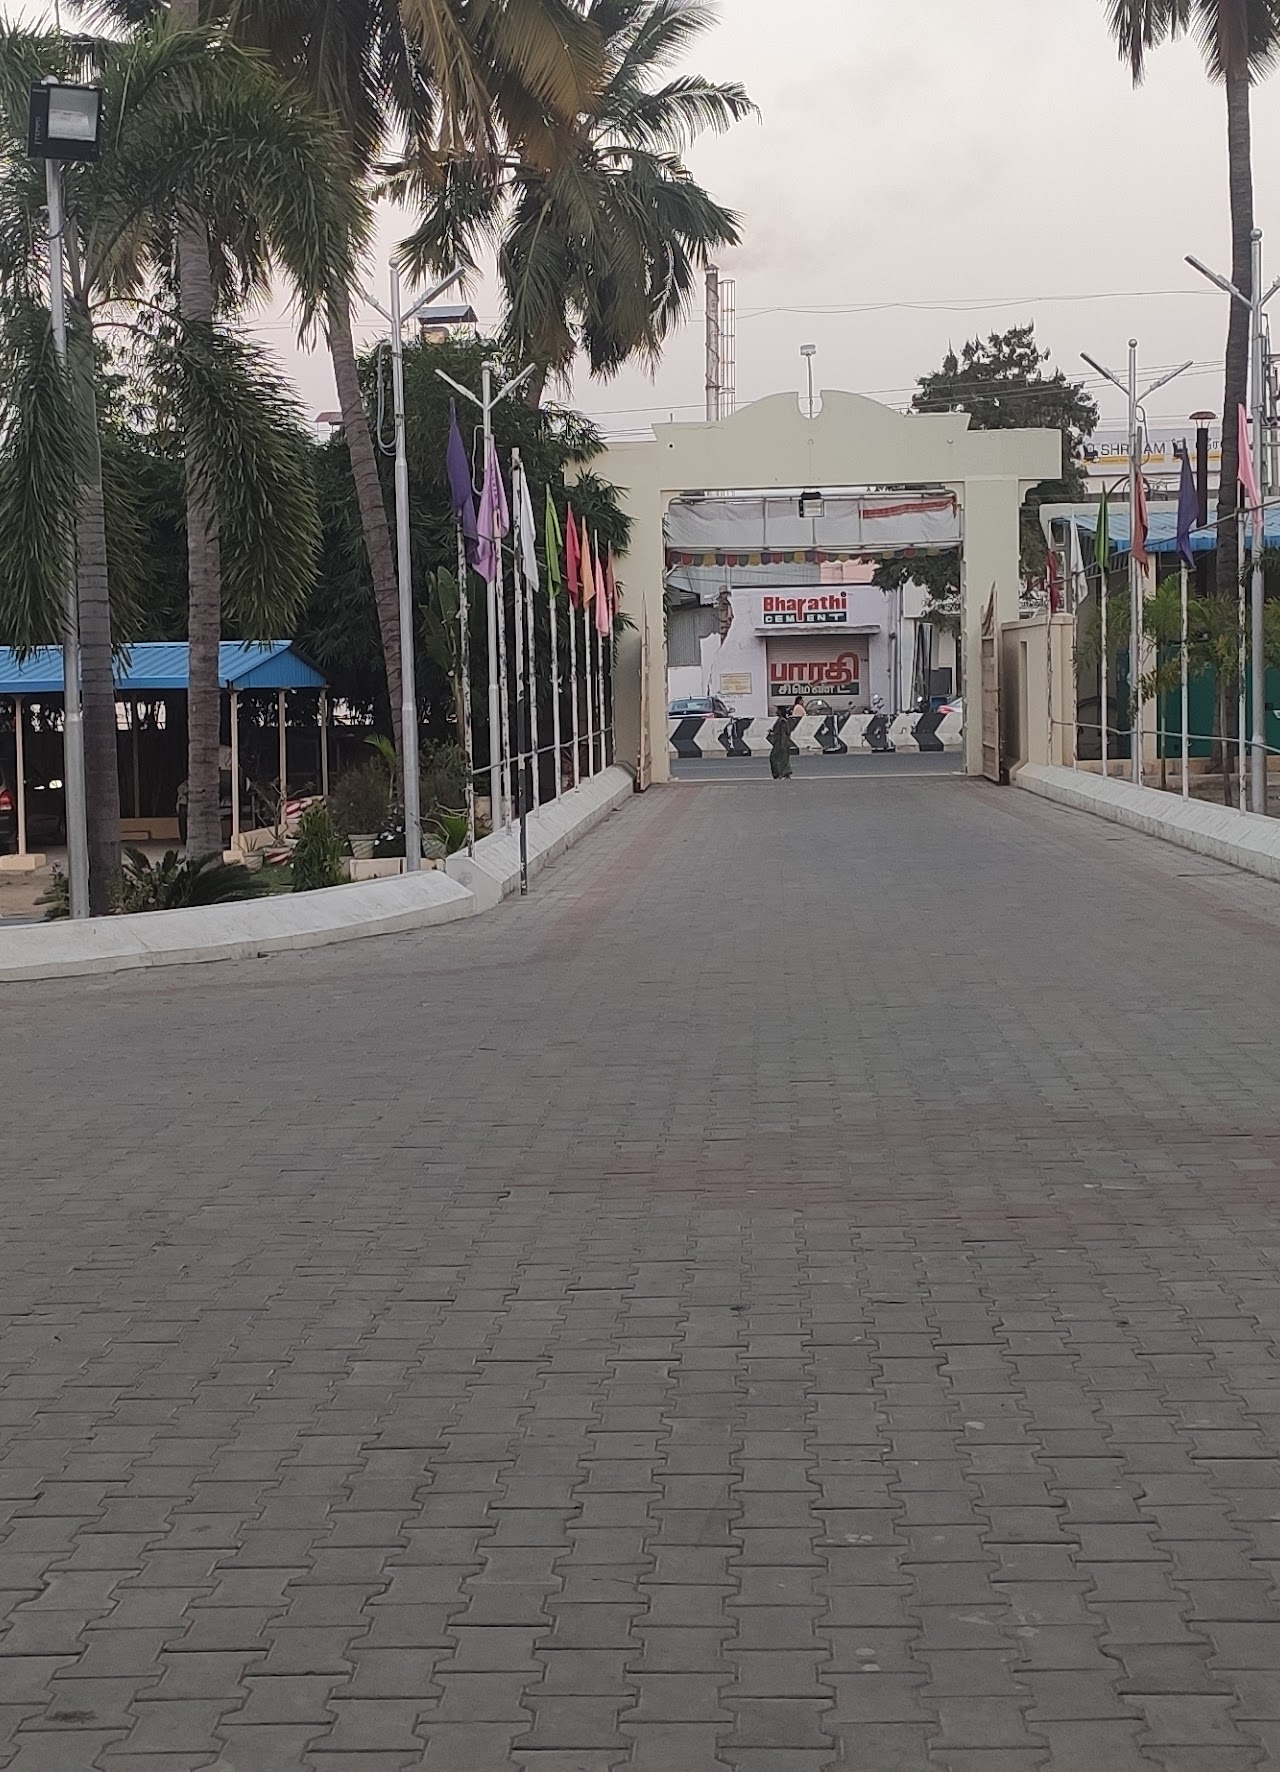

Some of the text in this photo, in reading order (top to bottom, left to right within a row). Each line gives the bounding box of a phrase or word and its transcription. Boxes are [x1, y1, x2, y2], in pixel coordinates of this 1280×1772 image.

[1101, 442, 1166, 456] SHRAM
[763, 591, 847, 621] Bharathi
[765, 613, 845, 623] CEMENT
[771, 652, 860, 686] பாரதி
